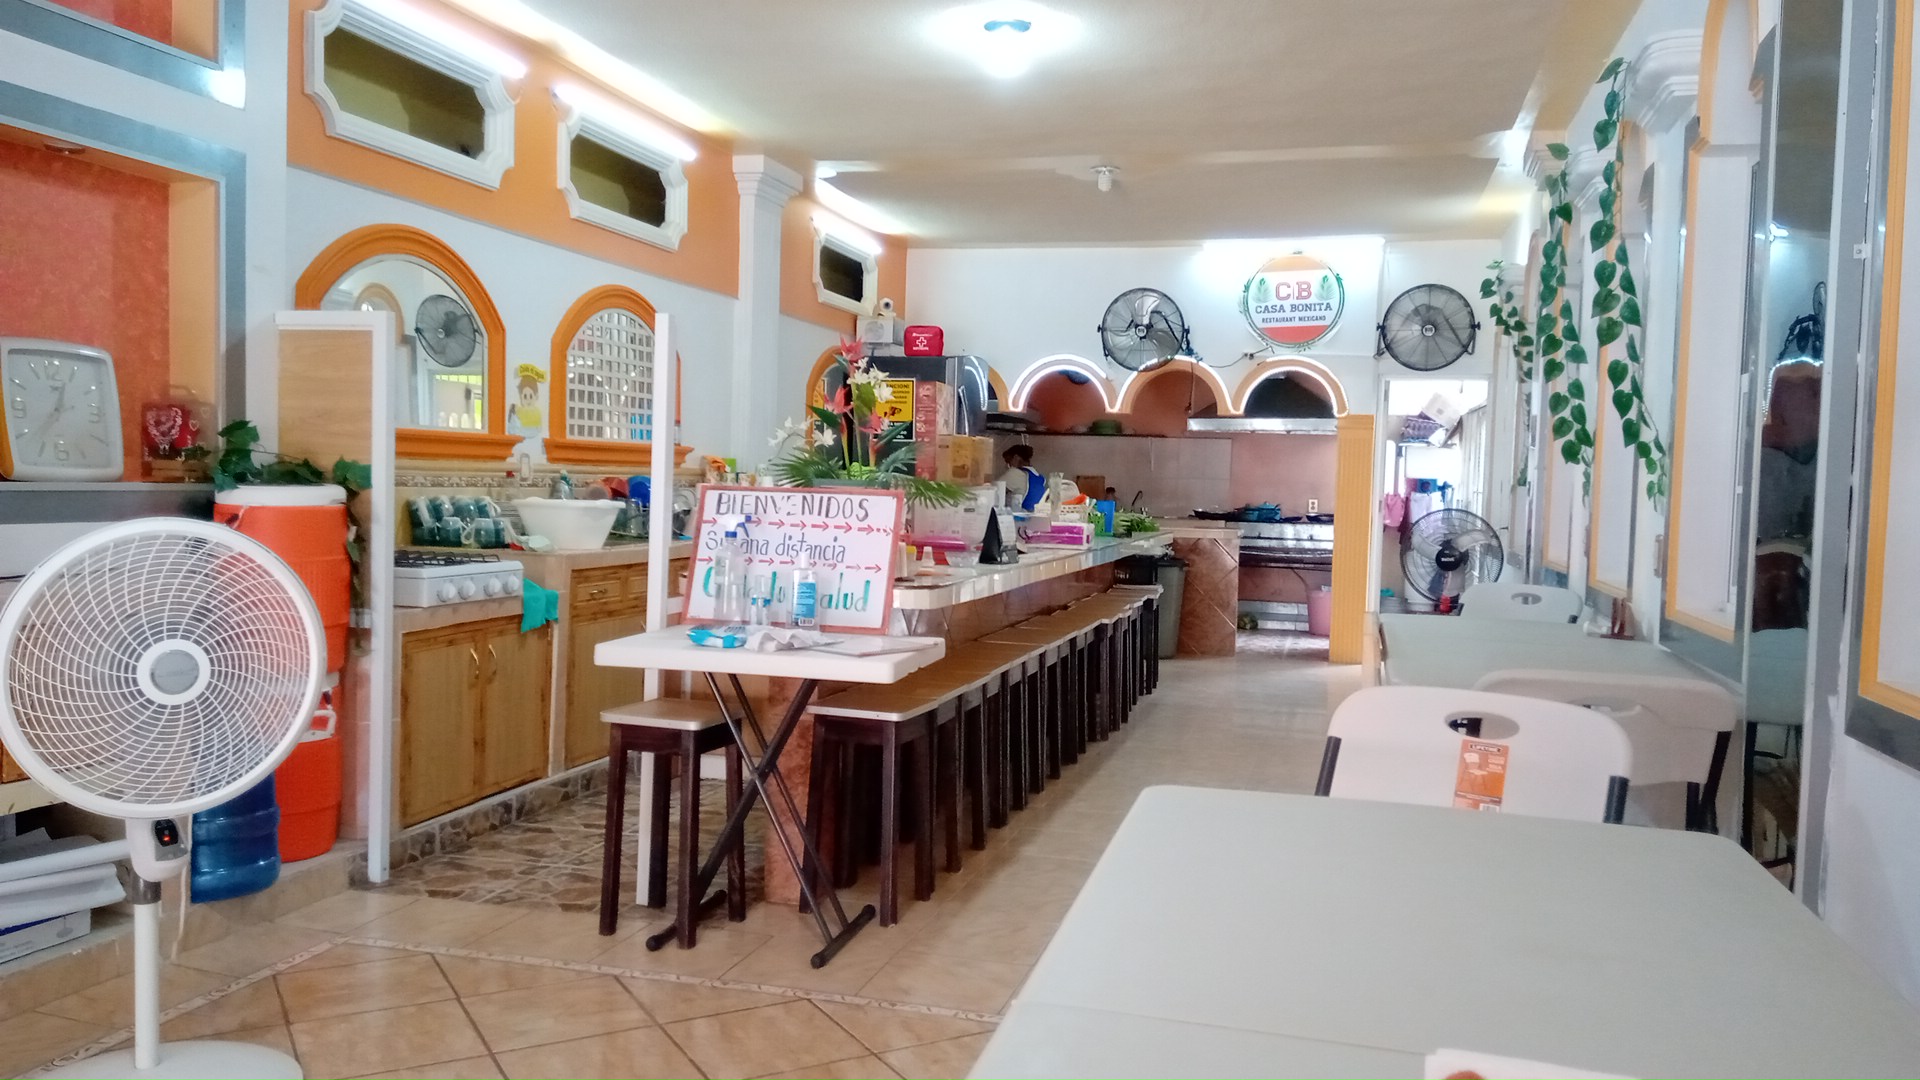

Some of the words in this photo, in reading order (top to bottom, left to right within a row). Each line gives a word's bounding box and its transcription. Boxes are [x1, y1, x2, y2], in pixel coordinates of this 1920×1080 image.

[1255, 304, 1286, 314] CASA
[1290, 302, 1333, 312] BONITA
[716, 492, 869, 522] BIENVENIDOS
[739, 538, 770, 555] ana
[819, 572, 871, 613] alud
